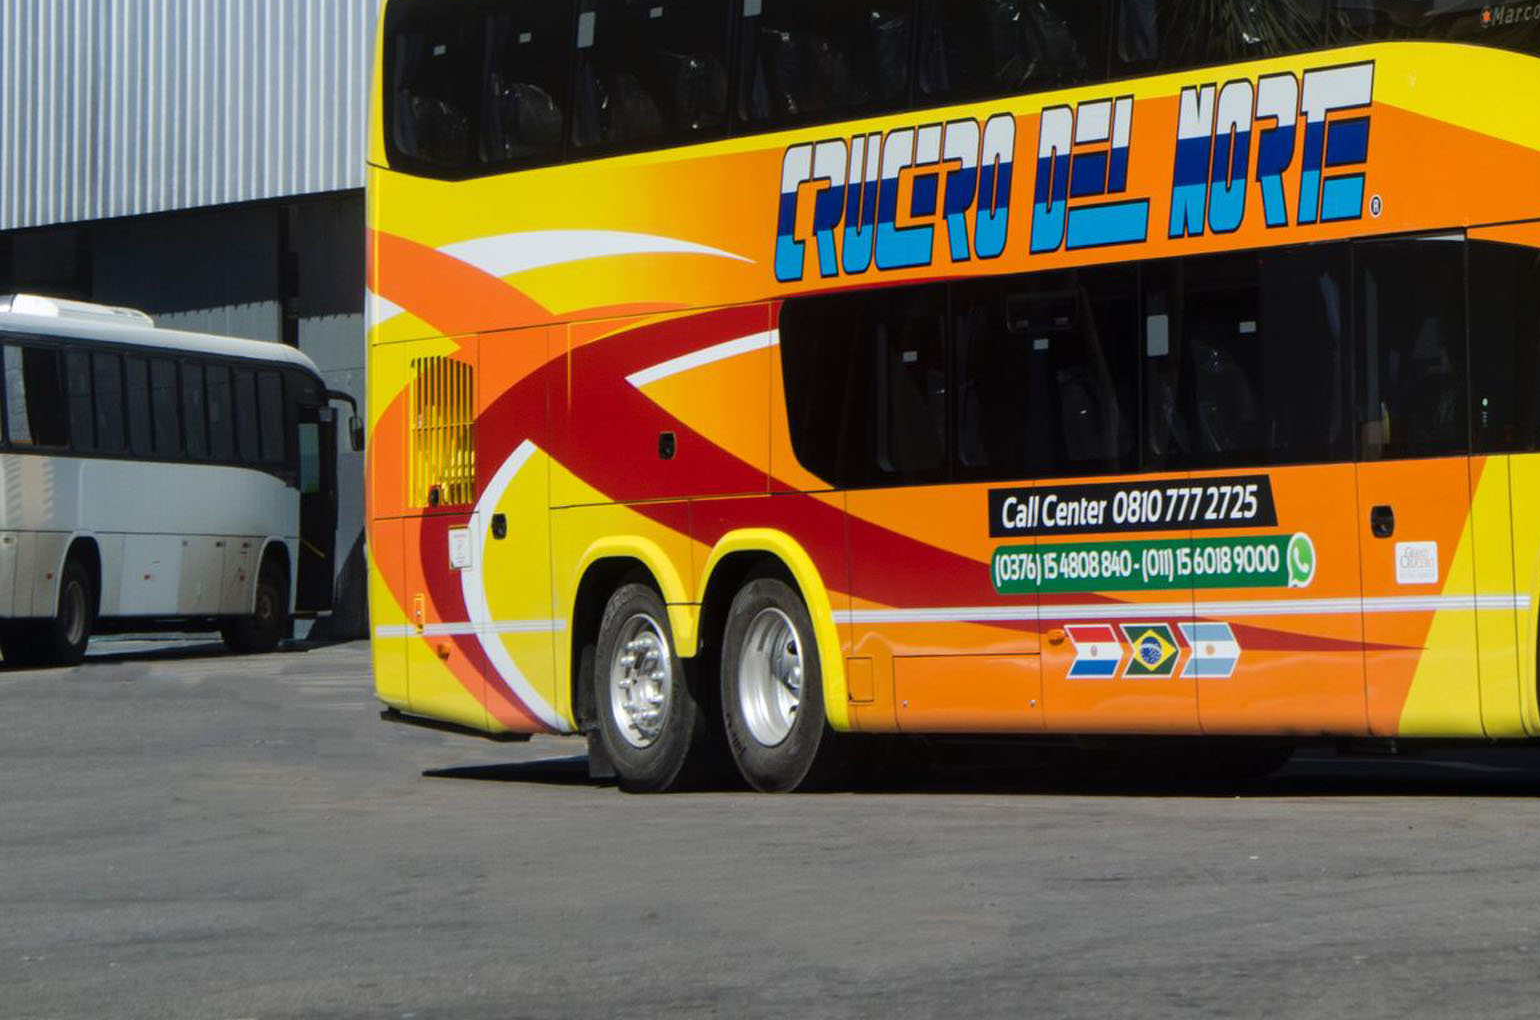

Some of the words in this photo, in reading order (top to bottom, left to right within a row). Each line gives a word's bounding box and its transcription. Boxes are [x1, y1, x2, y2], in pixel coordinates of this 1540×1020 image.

[774, 112, 1016, 281] CRUCERO
[1030, 95, 1149, 254] DEL
[1168, 60, 1375, 239] NORTE
[1002, 496, 1039, 528] Call
[1042, 495, 1107, 526] Center
[1112, 490, 1162, 524] 0810
[1165, 488, 1203, 521] 777
[1204, 485, 1258, 520] 2725
[995, 553, 1041, 587] (0376)
[1043, 553, 1058, 579] 15
[1060, 551, 1100, 578] 4808
[1102, 550, 1132, 577] 840
[1142, 548, 1174, 582] (011)
[1236, 545, 1279, 573] 9000
